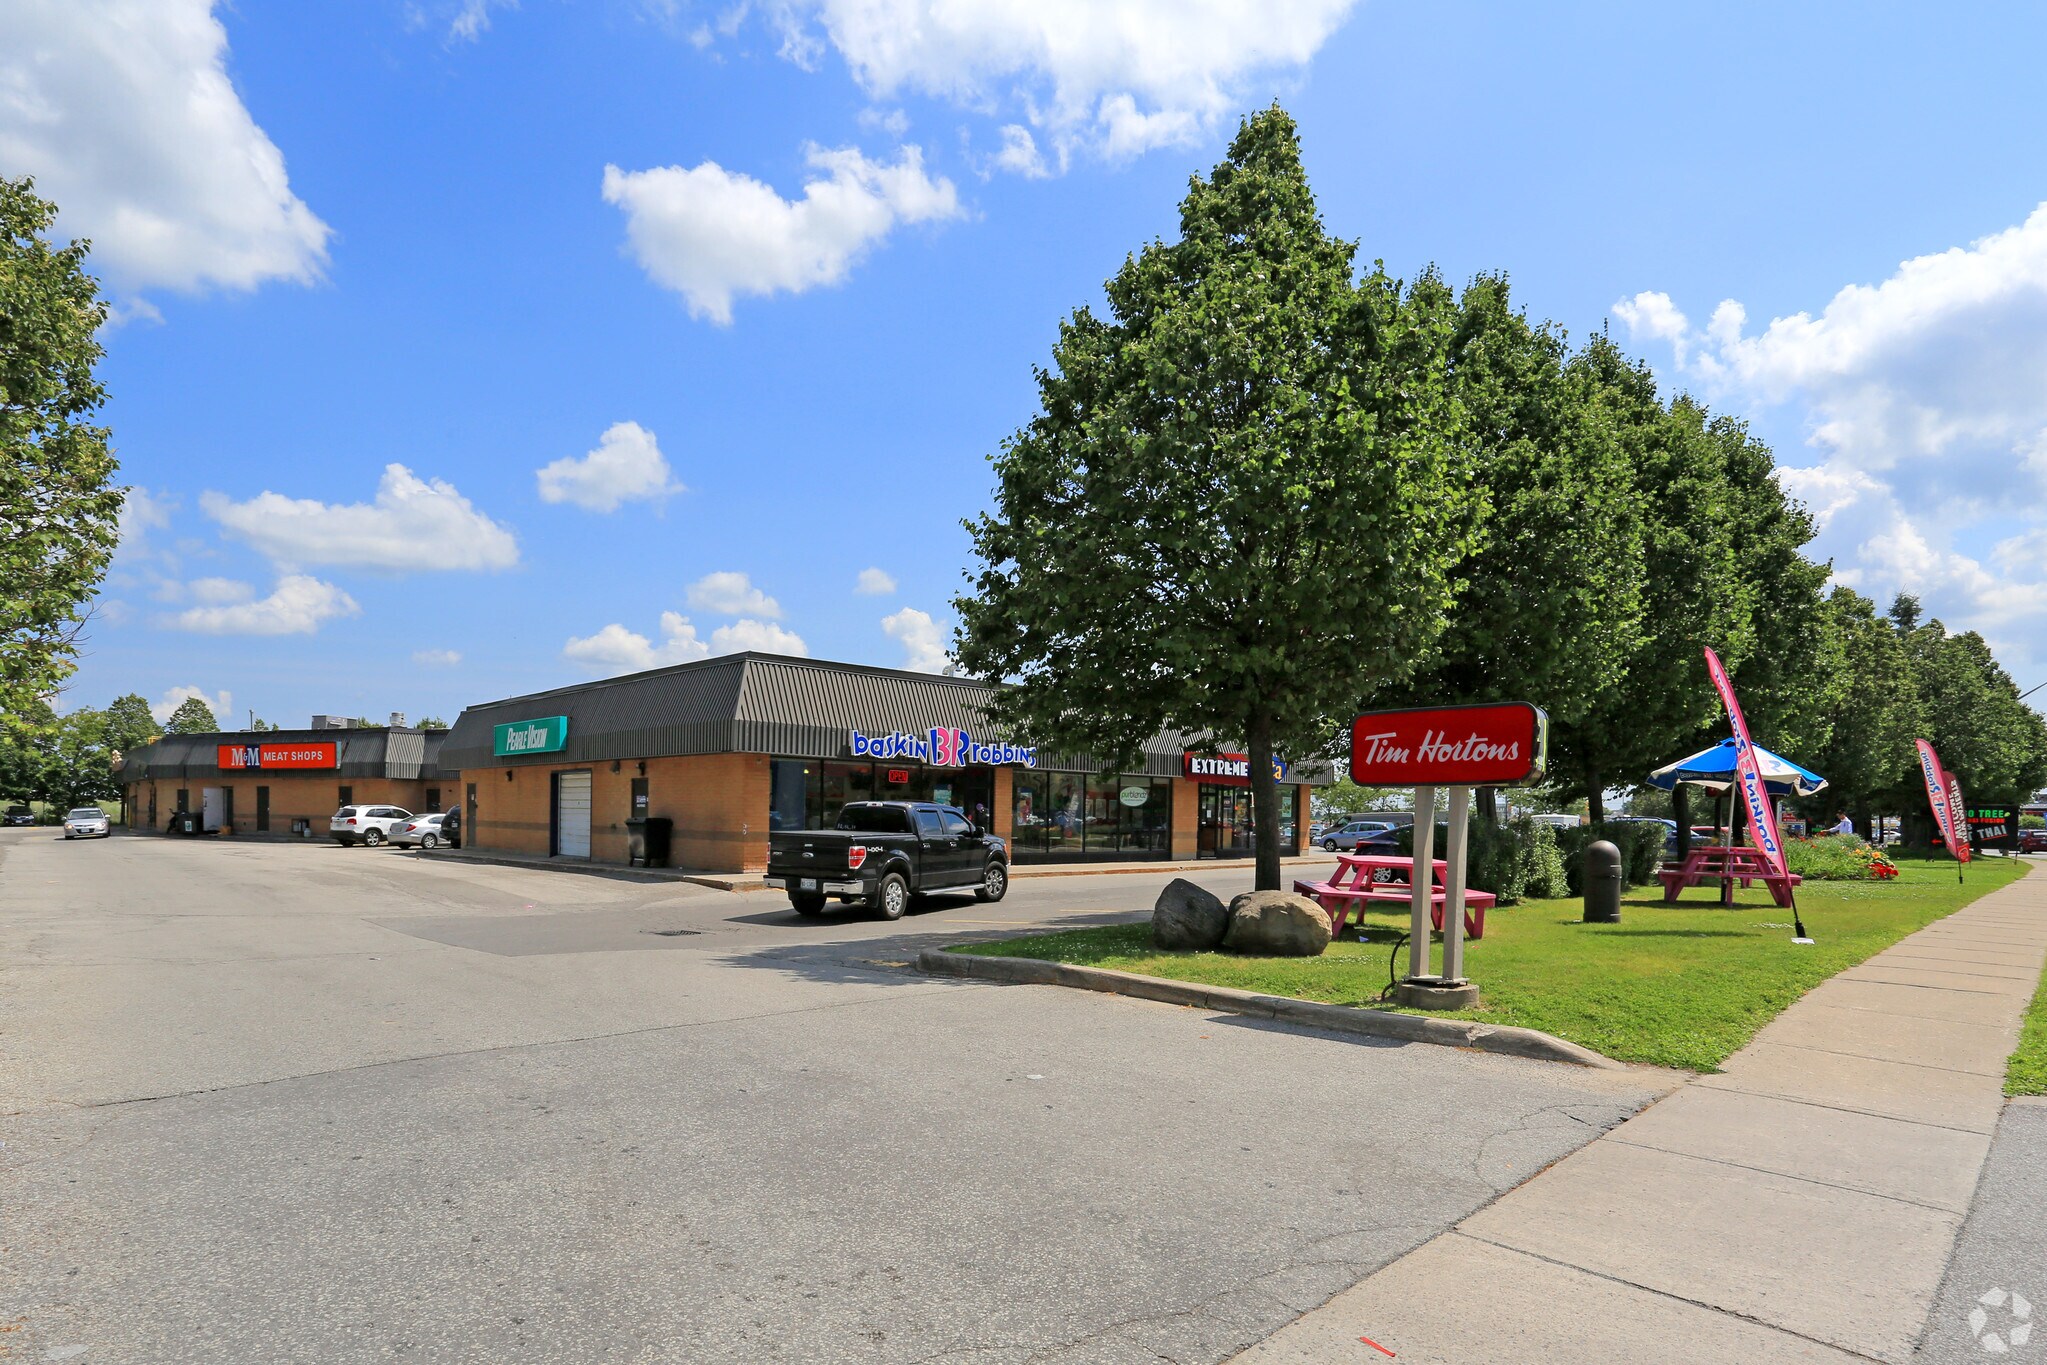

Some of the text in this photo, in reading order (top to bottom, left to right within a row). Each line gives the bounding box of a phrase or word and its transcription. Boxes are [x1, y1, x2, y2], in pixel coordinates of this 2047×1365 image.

[231, 747, 323, 766] M&M MEAT SHOPS
[852, 727, 1037, 768] baskin BR robbins
[1364, 729, 1519, 765] Tim Hortons
[889, 770, 907, 782] OPEN
[1191, 757, 1249, 777] EXTREME
[1978, 810, 2004, 818] TREE
[1976, 824, 2007, 839] THAI
